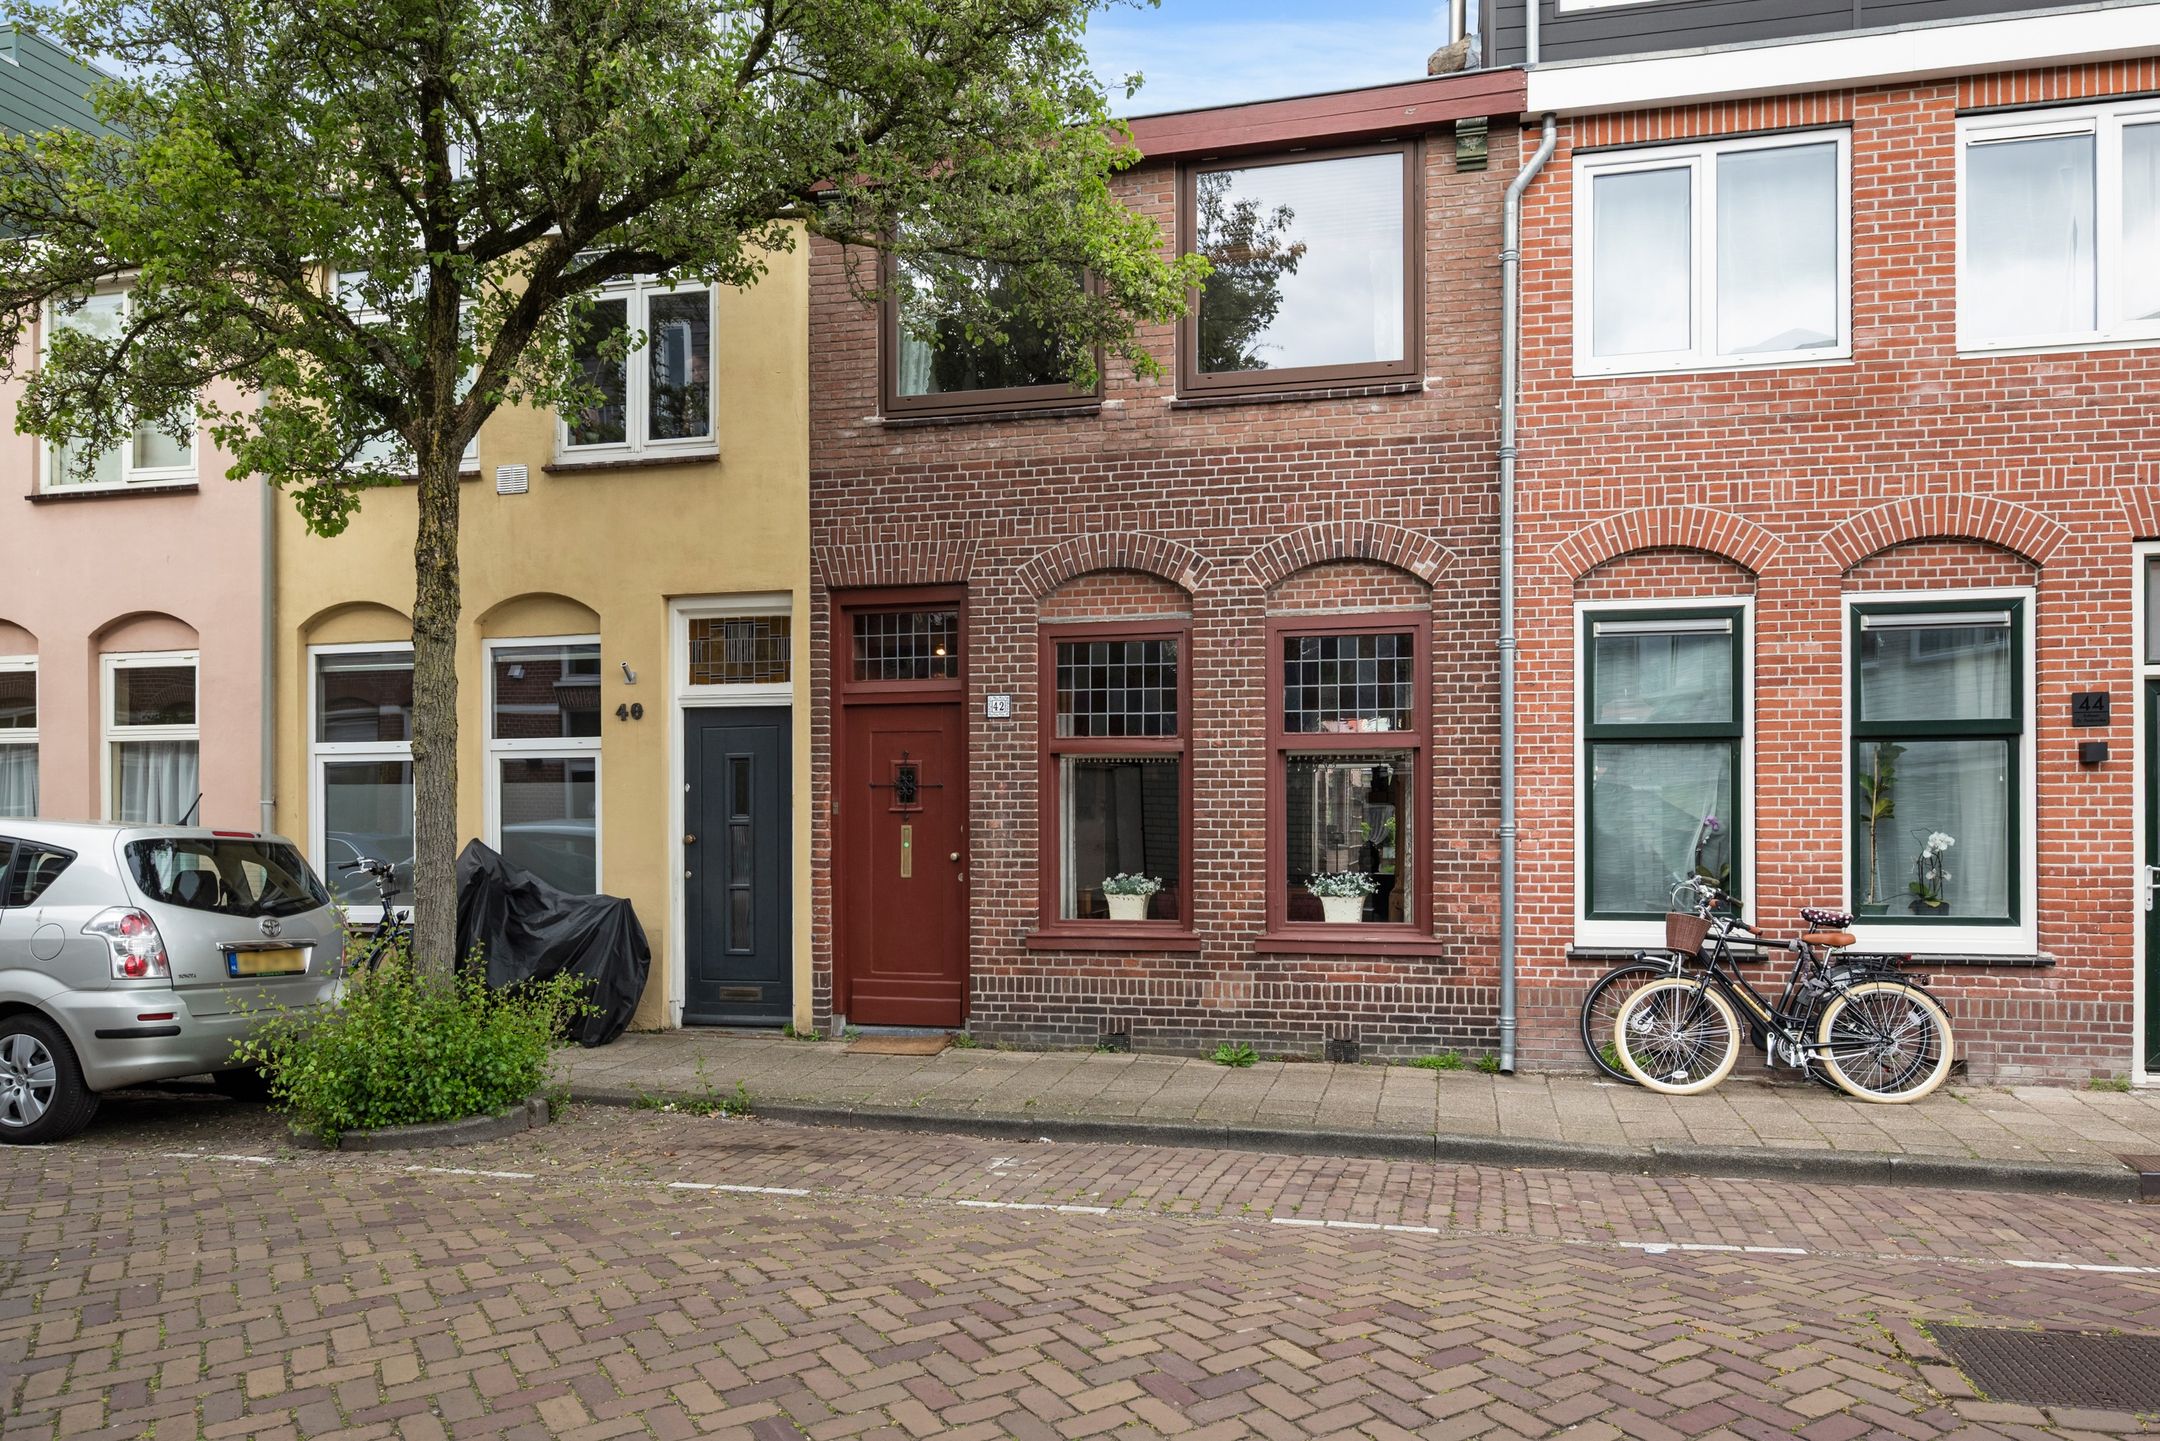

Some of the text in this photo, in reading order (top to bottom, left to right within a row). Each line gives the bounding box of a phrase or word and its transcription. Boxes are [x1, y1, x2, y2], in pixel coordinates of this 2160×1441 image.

[993, 701, 1004, 711] 42
[2079, 696, 2104, 710] 44
[615, 703, 643, 721] 40
